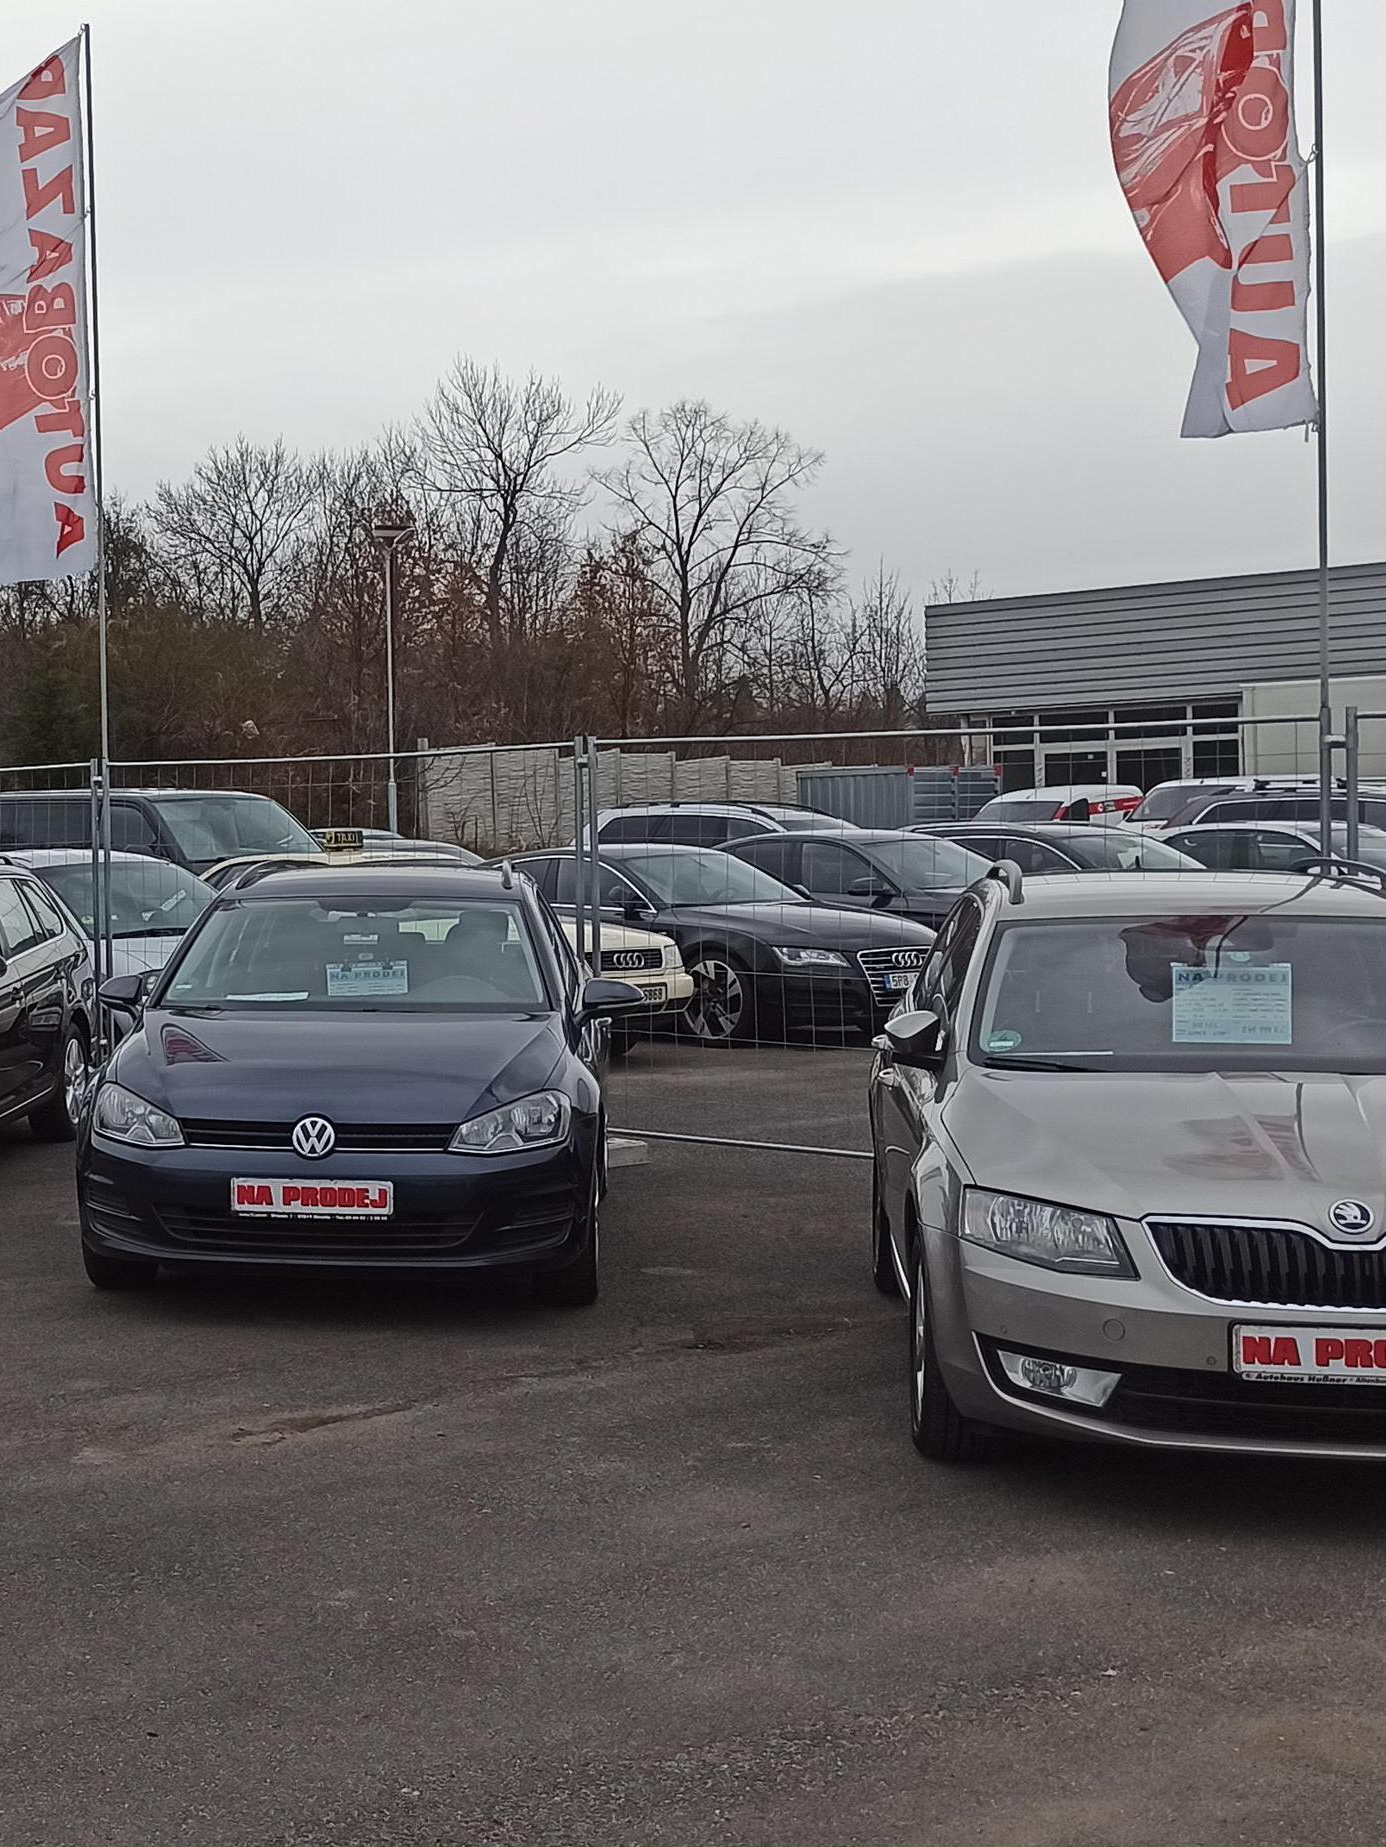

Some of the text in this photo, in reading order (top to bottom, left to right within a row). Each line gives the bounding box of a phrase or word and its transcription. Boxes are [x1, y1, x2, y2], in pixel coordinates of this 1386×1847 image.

[336, 832, 355, 843] TAXI
[1178, 973, 1205, 982] NA
[236, 1184, 388, 1208] NA PRODEJ
[1242, 1336, 1302, 1366] NA
